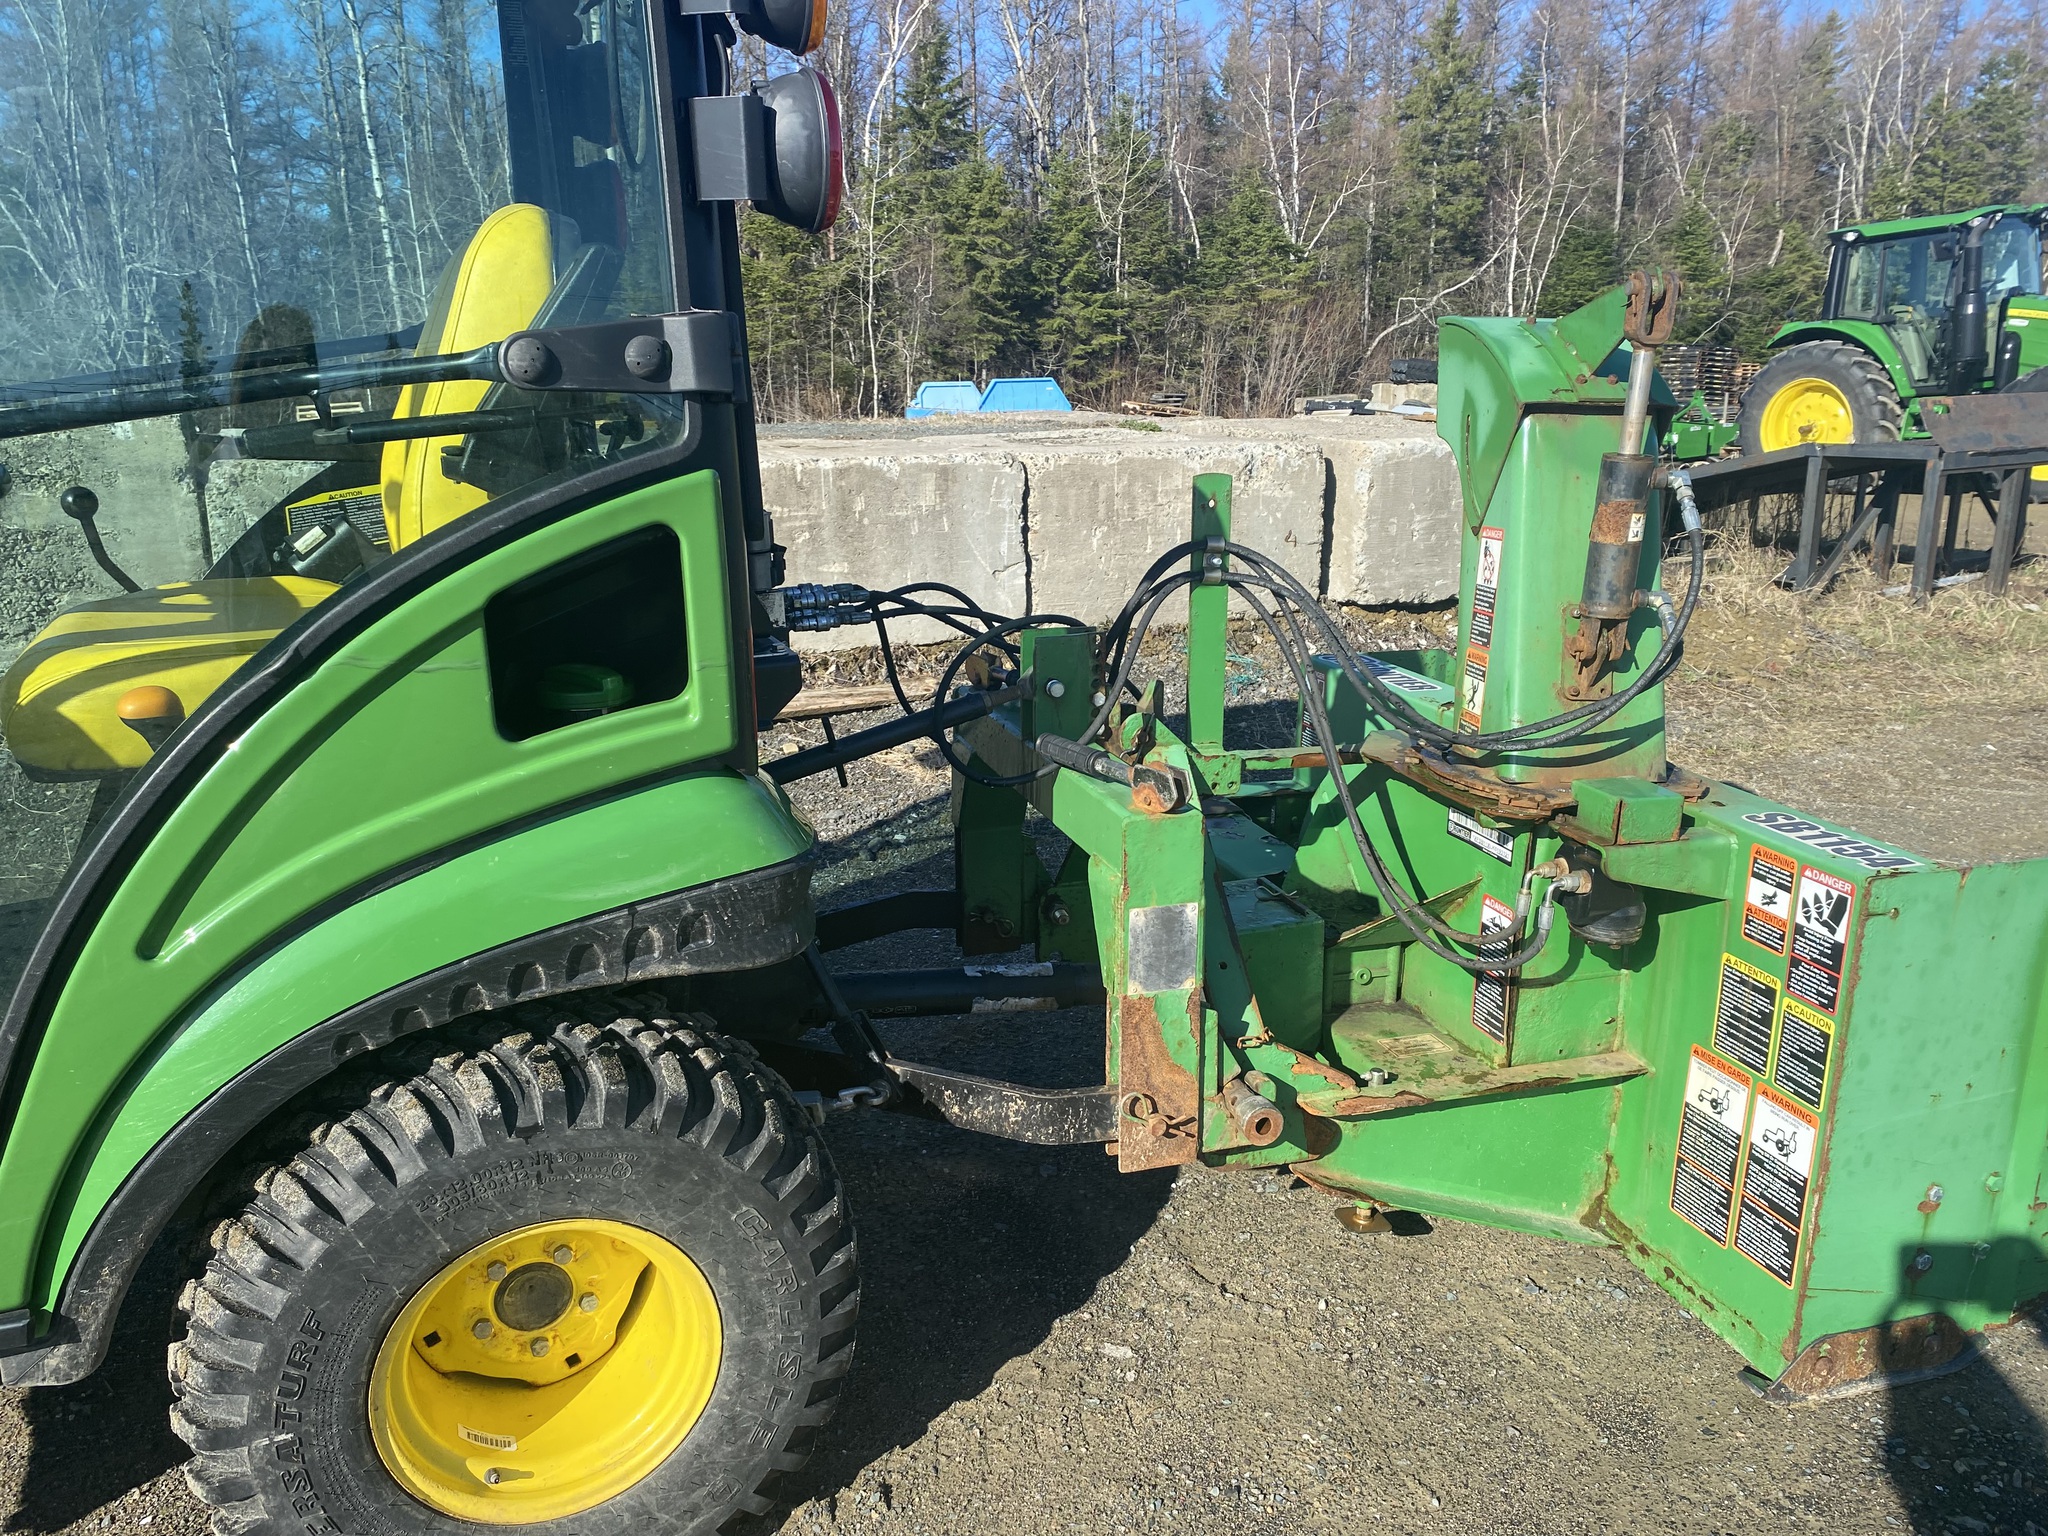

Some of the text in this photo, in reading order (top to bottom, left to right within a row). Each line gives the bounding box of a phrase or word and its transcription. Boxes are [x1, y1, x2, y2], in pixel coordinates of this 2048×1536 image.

[334, 490, 363, 499] CAUTION
[1487, 528, 1503, 539] DANGER
[1744, 813, 1921, 868] SB1154
[1762, 850, 1795, 870] WARNING
[1812, 871, 1852, 893] DANGER
[1490, 899, 1513, 920] DANGER
[1752, 907, 1787, 929] ATTENTION
[1733, 959, 1777, 987] ATTENTION
[1792, 1006, 1832, 1031] CAUTION
[1700, 1050, 1751, 1085] MISE EN GARDE
[1771, 1092, 1812, 1123] WARNING
[734, 1207, 804, 1450] CARLISLE
[274, 1308, 343, 1536] ERSATURF
